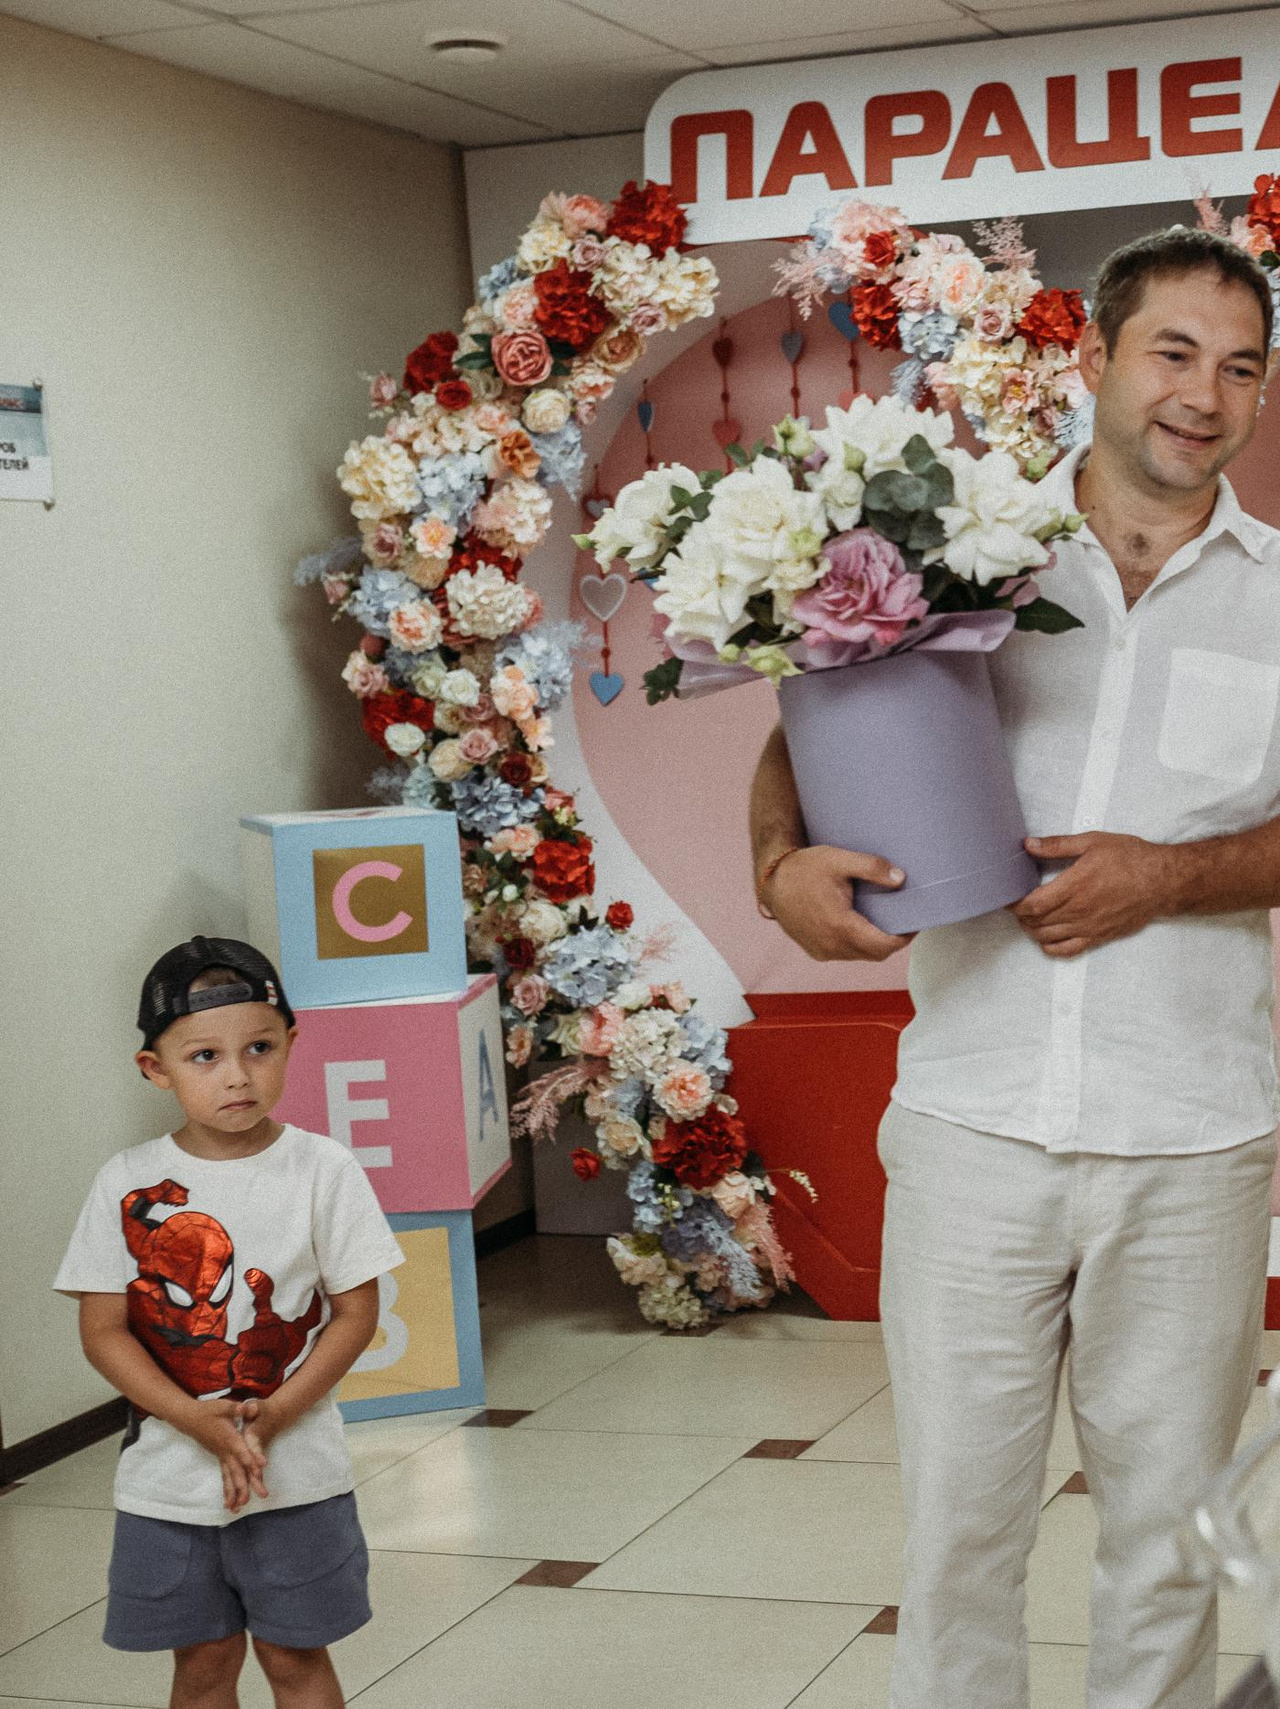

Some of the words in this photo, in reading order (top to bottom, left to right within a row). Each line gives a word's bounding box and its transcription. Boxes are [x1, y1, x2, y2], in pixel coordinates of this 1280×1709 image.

[332, 861, 413, 942] C
[324, 1060, 393, 1168] E
[478, 1028, 499, 1142] A
